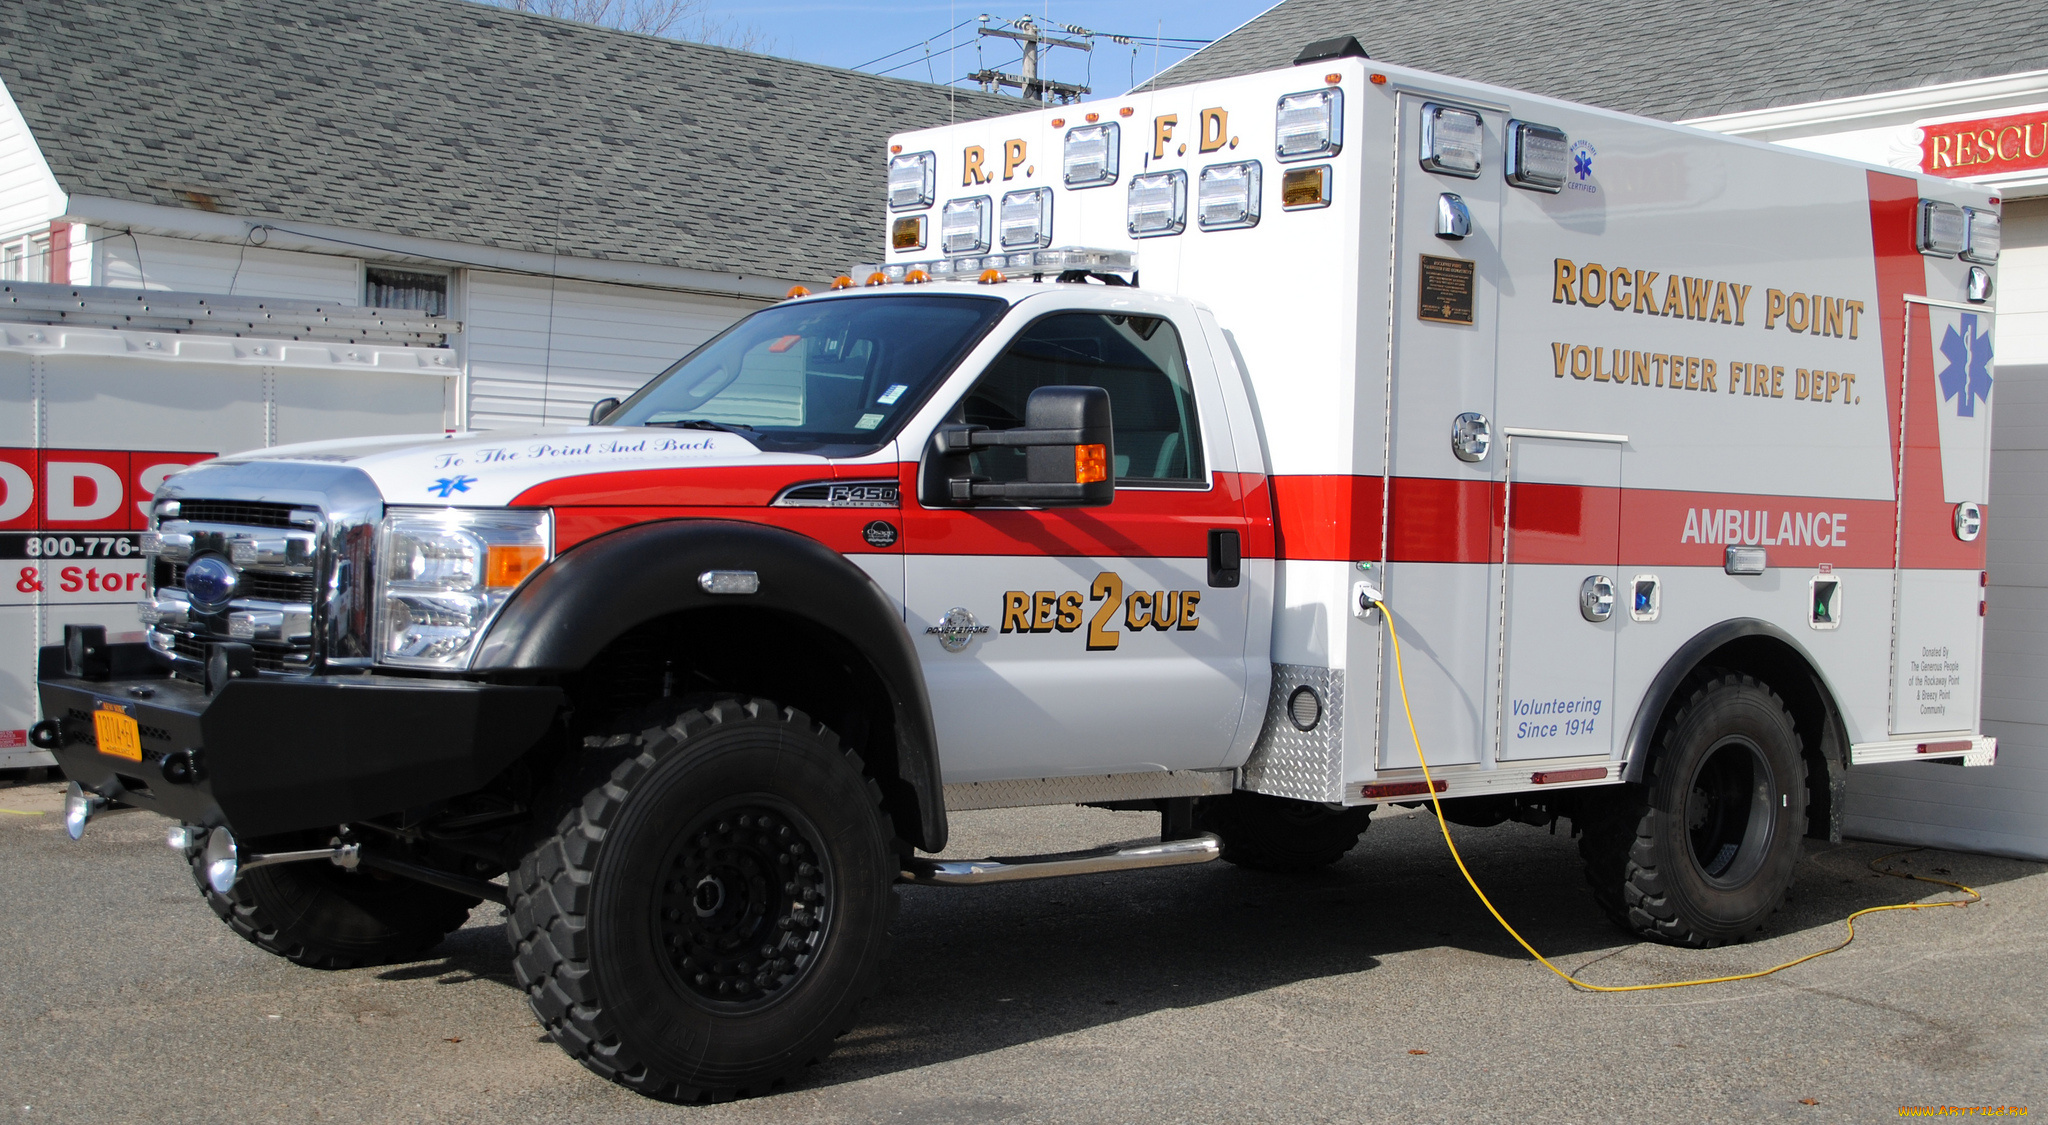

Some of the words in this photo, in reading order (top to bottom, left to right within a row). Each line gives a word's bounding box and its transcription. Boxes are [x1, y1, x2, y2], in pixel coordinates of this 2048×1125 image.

[1567, 181, 1597, 193] CERTIFIED
[1552, 257, 1752, 326] ROCKAWAY
[1764, 288, 1864, 340] POINT
[1550, 341, 1717, 393] VOLUNTEER
[1729, 361, 1784, 399] FIRE
[1795, 368, 1861, 405] DEPT.
[434, 453, 464, 469] To
[475, 449, 520, 465] The
[528, 443, 592, 459] Point
[598, 439, 648, 456] And
[653, 437, 716, 451] Back
[1681, 508, 1847, 547] AMBULANCE
[16, 566, 45, 593] &
[925, 626, 956, 635] POWER
[957, 626, 990, 635] STROKE
[1922, 646, 1941, 657] Donated
[1942, 646, 1949, 659] By
[1911, 661, 1919, 671] The
[1921, 661, 1942, 671] Generous
[1944, 661, 1959, 673] People
[1908, 675, 1914, 686] of
[1924, 675, 1947, 687] Rockaway
[1948, 675, 1960, 686] Point
[1922, 690, 1938, 701] Breezy
[1939, 690, 1950, 700] Point
[1513, 696, 1602, 716] Volunteering
[1920, 704, 1945, 716] Community
[1517, 721, 1557, 739] Since
[1565, 719, 1595, 735] 1914
